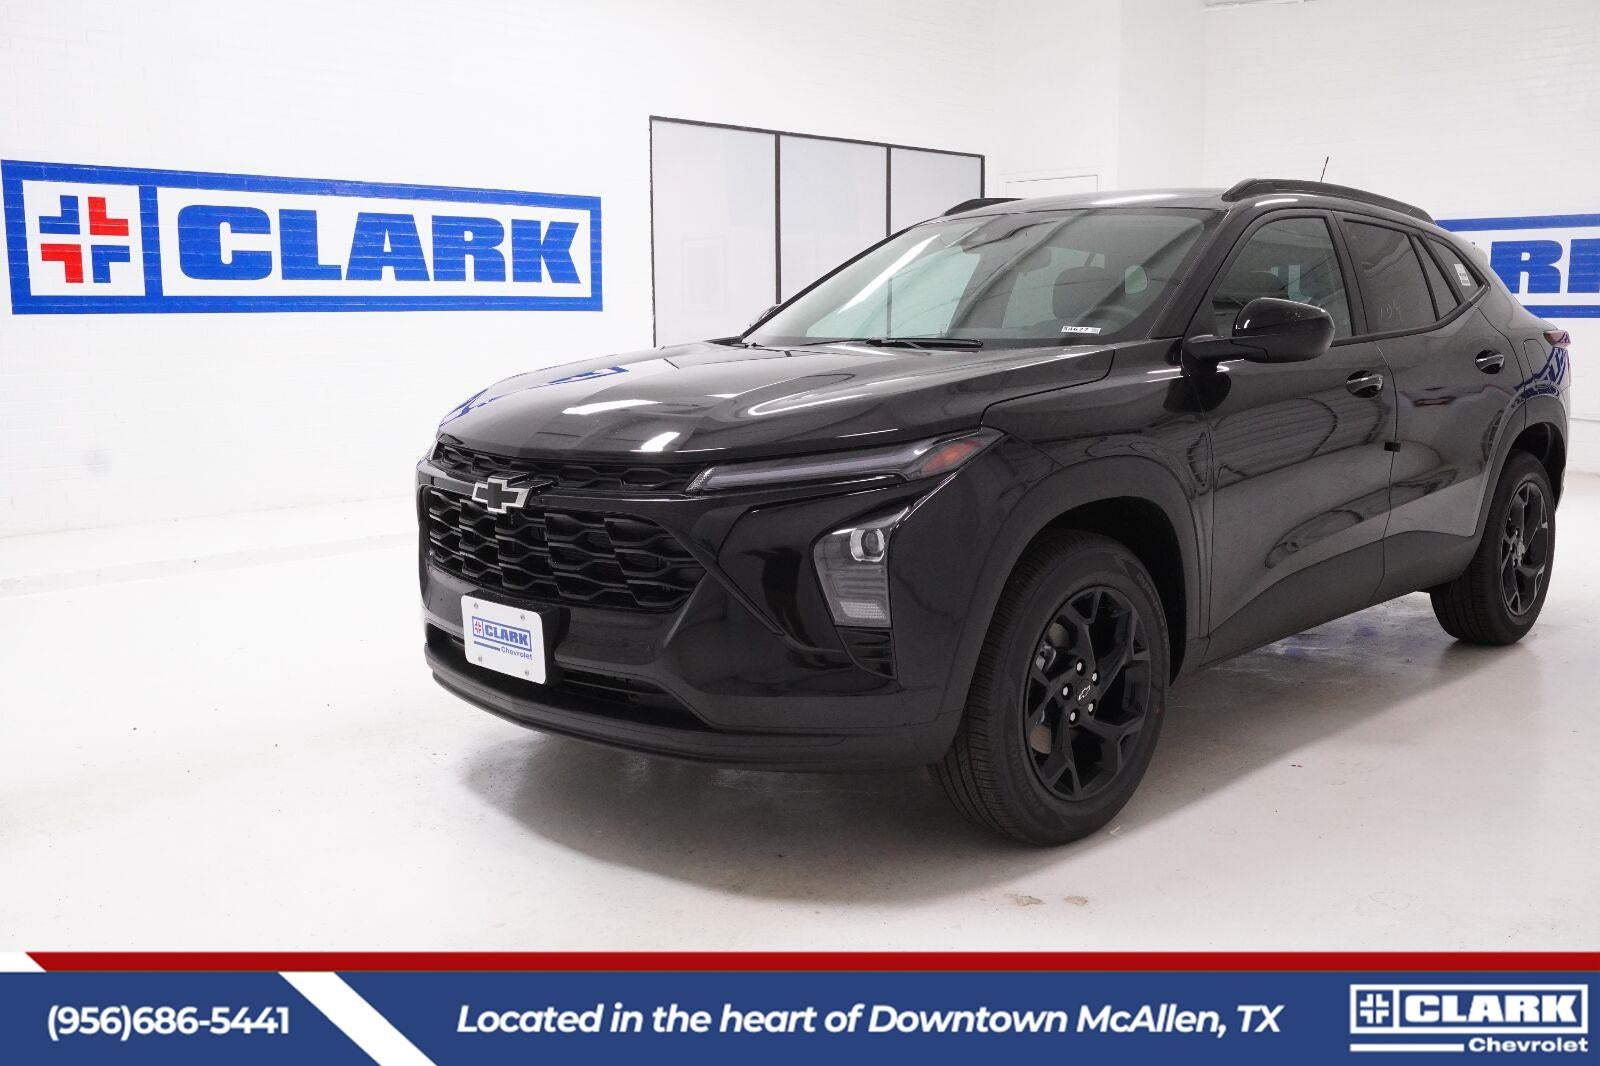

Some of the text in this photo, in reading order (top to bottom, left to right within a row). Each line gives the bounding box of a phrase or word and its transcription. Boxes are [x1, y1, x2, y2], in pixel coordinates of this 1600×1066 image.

[178, 204, 581, 283] CLARK
[484, 624, 528, 646] CLARK
[501, 646, 533, 661] Chevrolet
